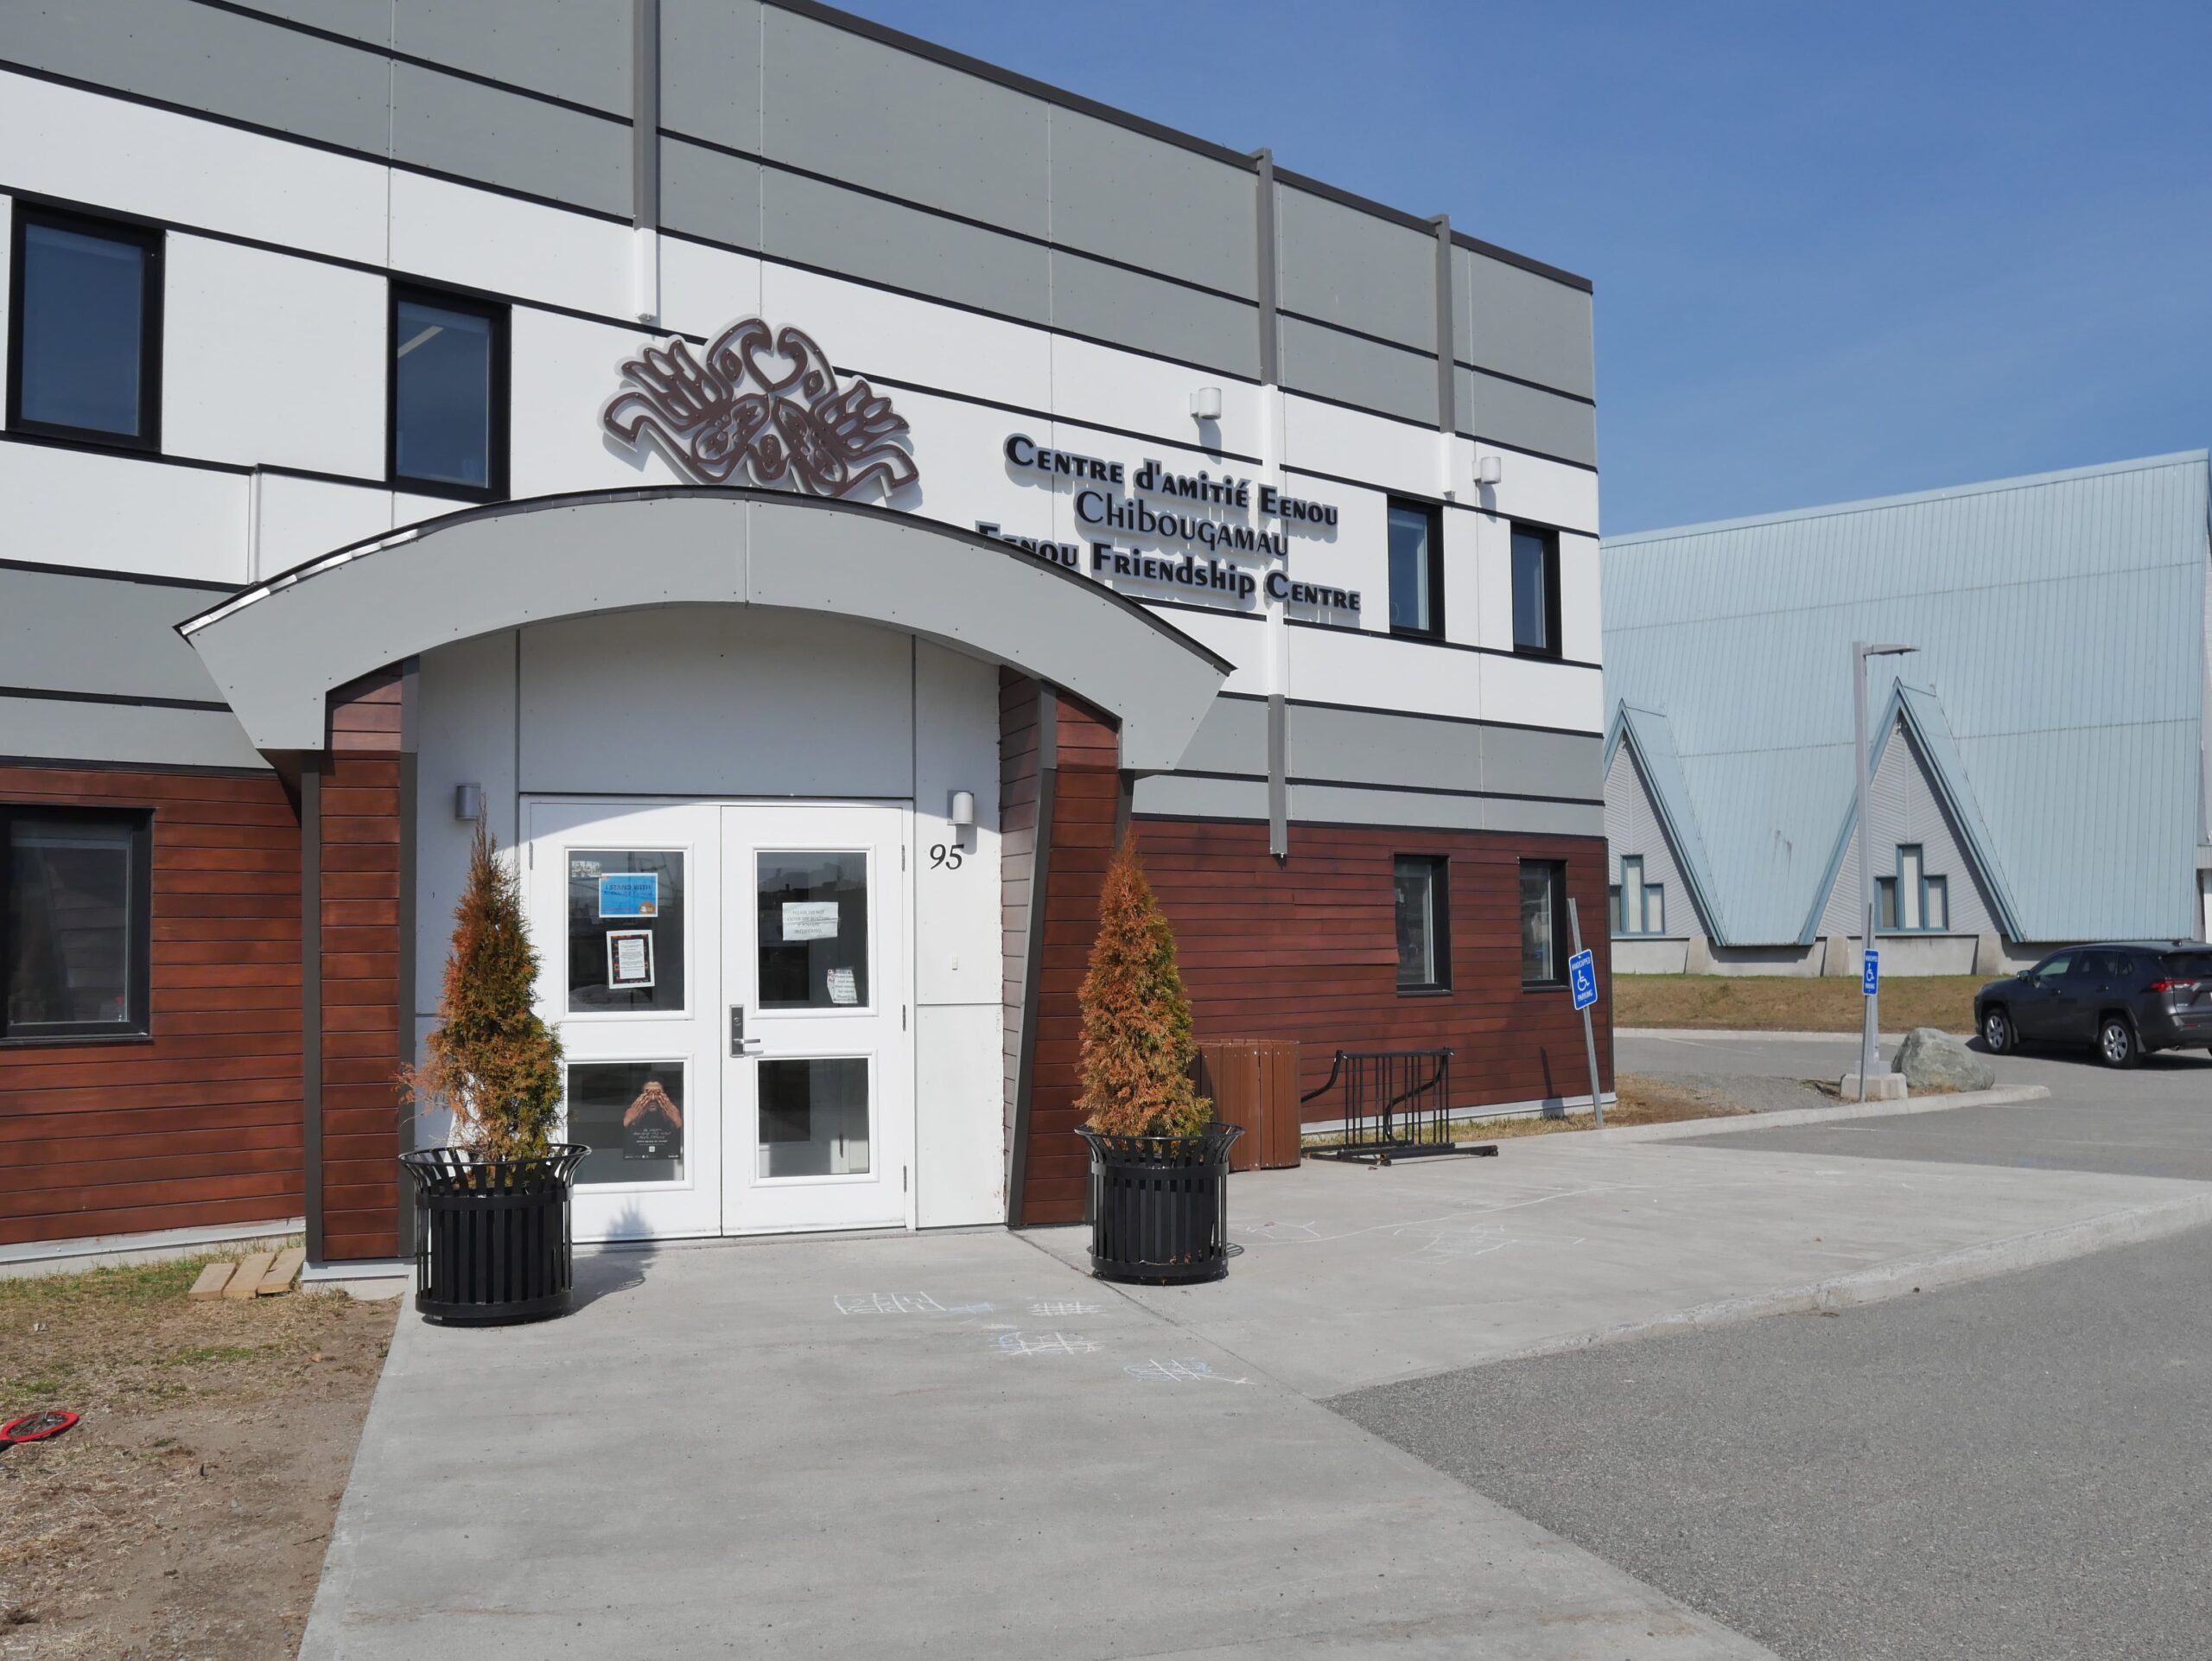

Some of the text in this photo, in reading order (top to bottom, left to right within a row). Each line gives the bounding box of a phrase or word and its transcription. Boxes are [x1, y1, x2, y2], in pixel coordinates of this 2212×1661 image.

[1007, 436, 1123, 484] CENTRE
[1261, 487, 1338, 525] EENOU
[1266, 572, 1360, 610] CENTRE
[930, 843, 964, 870] 95
[1578, 989, 1593, 1002] PARKING
